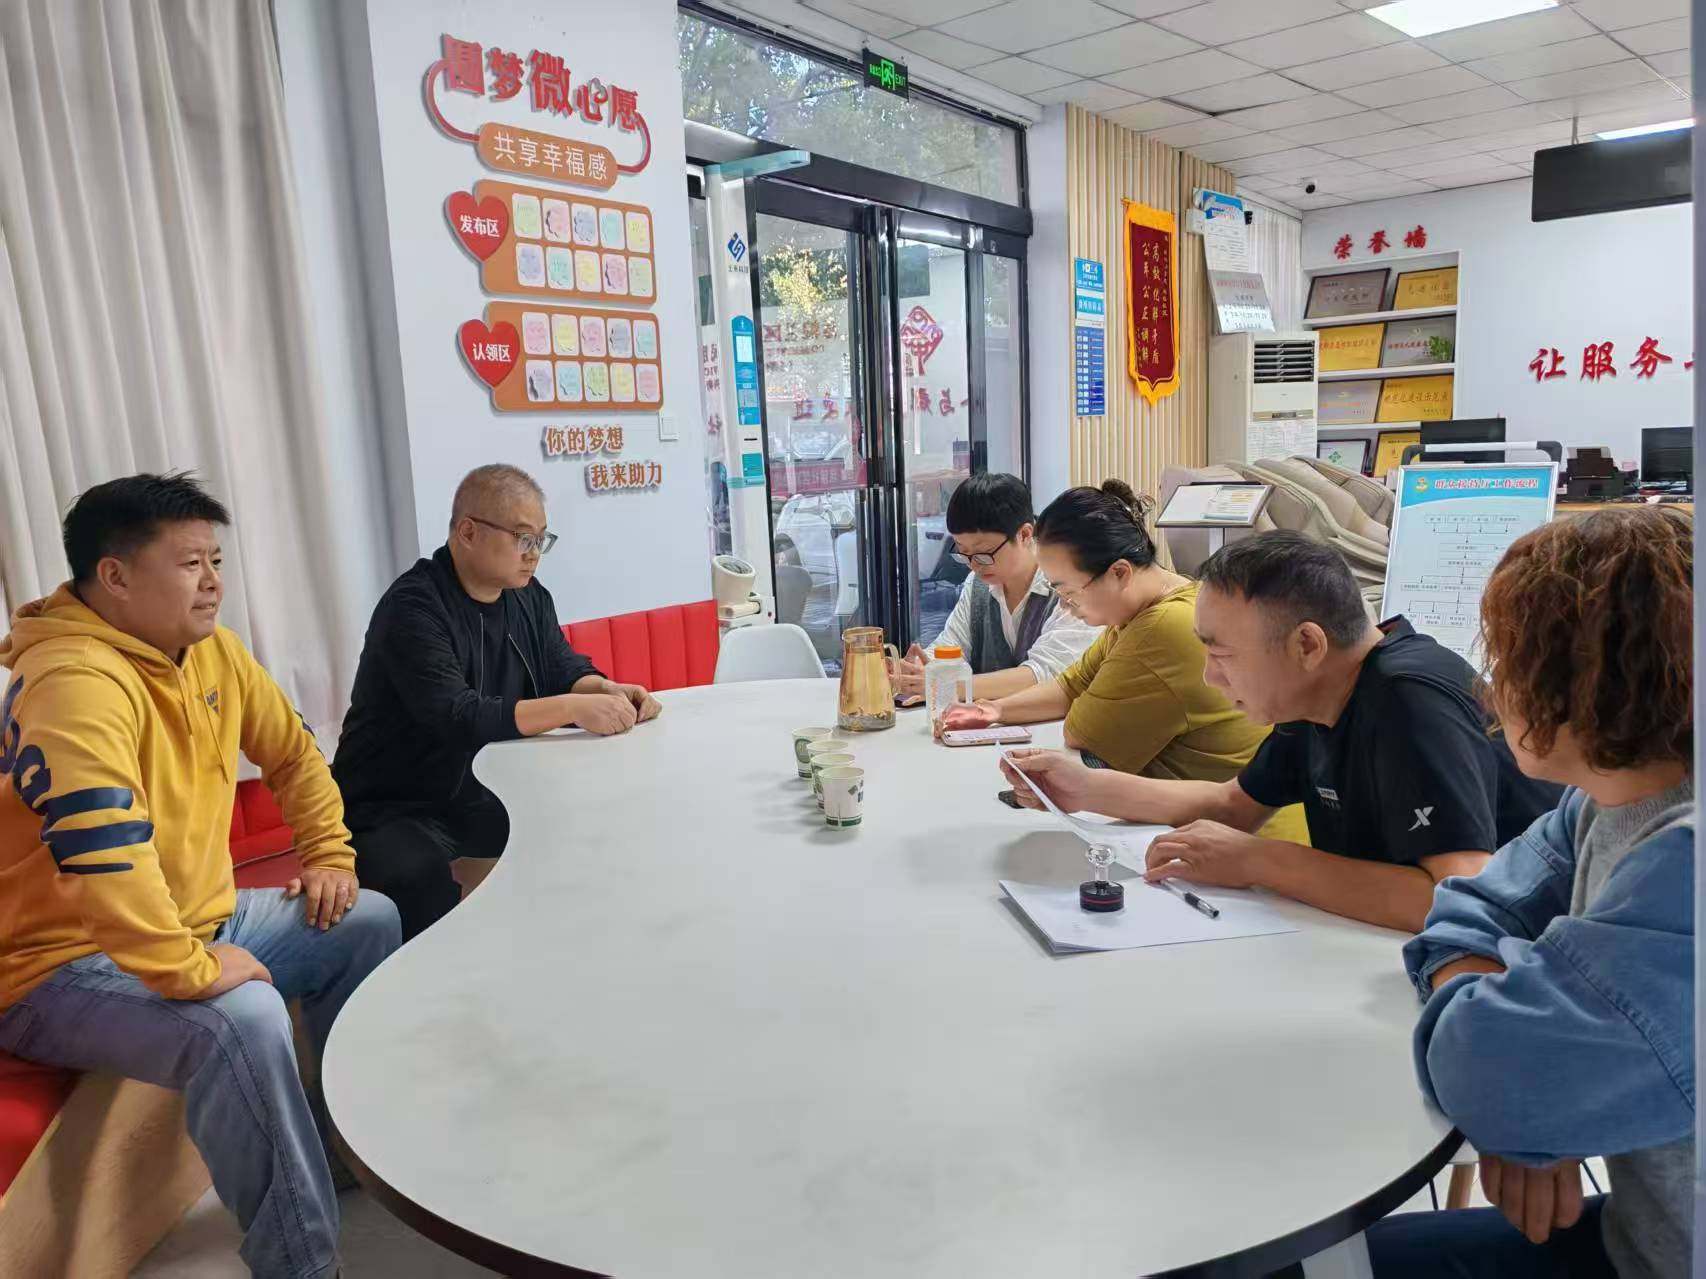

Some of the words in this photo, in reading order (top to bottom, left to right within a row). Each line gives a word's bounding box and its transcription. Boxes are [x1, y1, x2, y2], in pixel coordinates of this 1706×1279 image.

[442, 33, 642, 132] 圆梦微心愿
[493, 131, 608, 181] 共享幸福感
[460, 214, 500, 238] 发布区
[1334, 225, 1427, 260] 荣誉墙
[472, 343, 512, 363] 认领区
[1528, 336, 1694, 382] 让服务
[545, 426, 624, 453] 你的梦想
[590, 462, 663, 489] 我来助力
